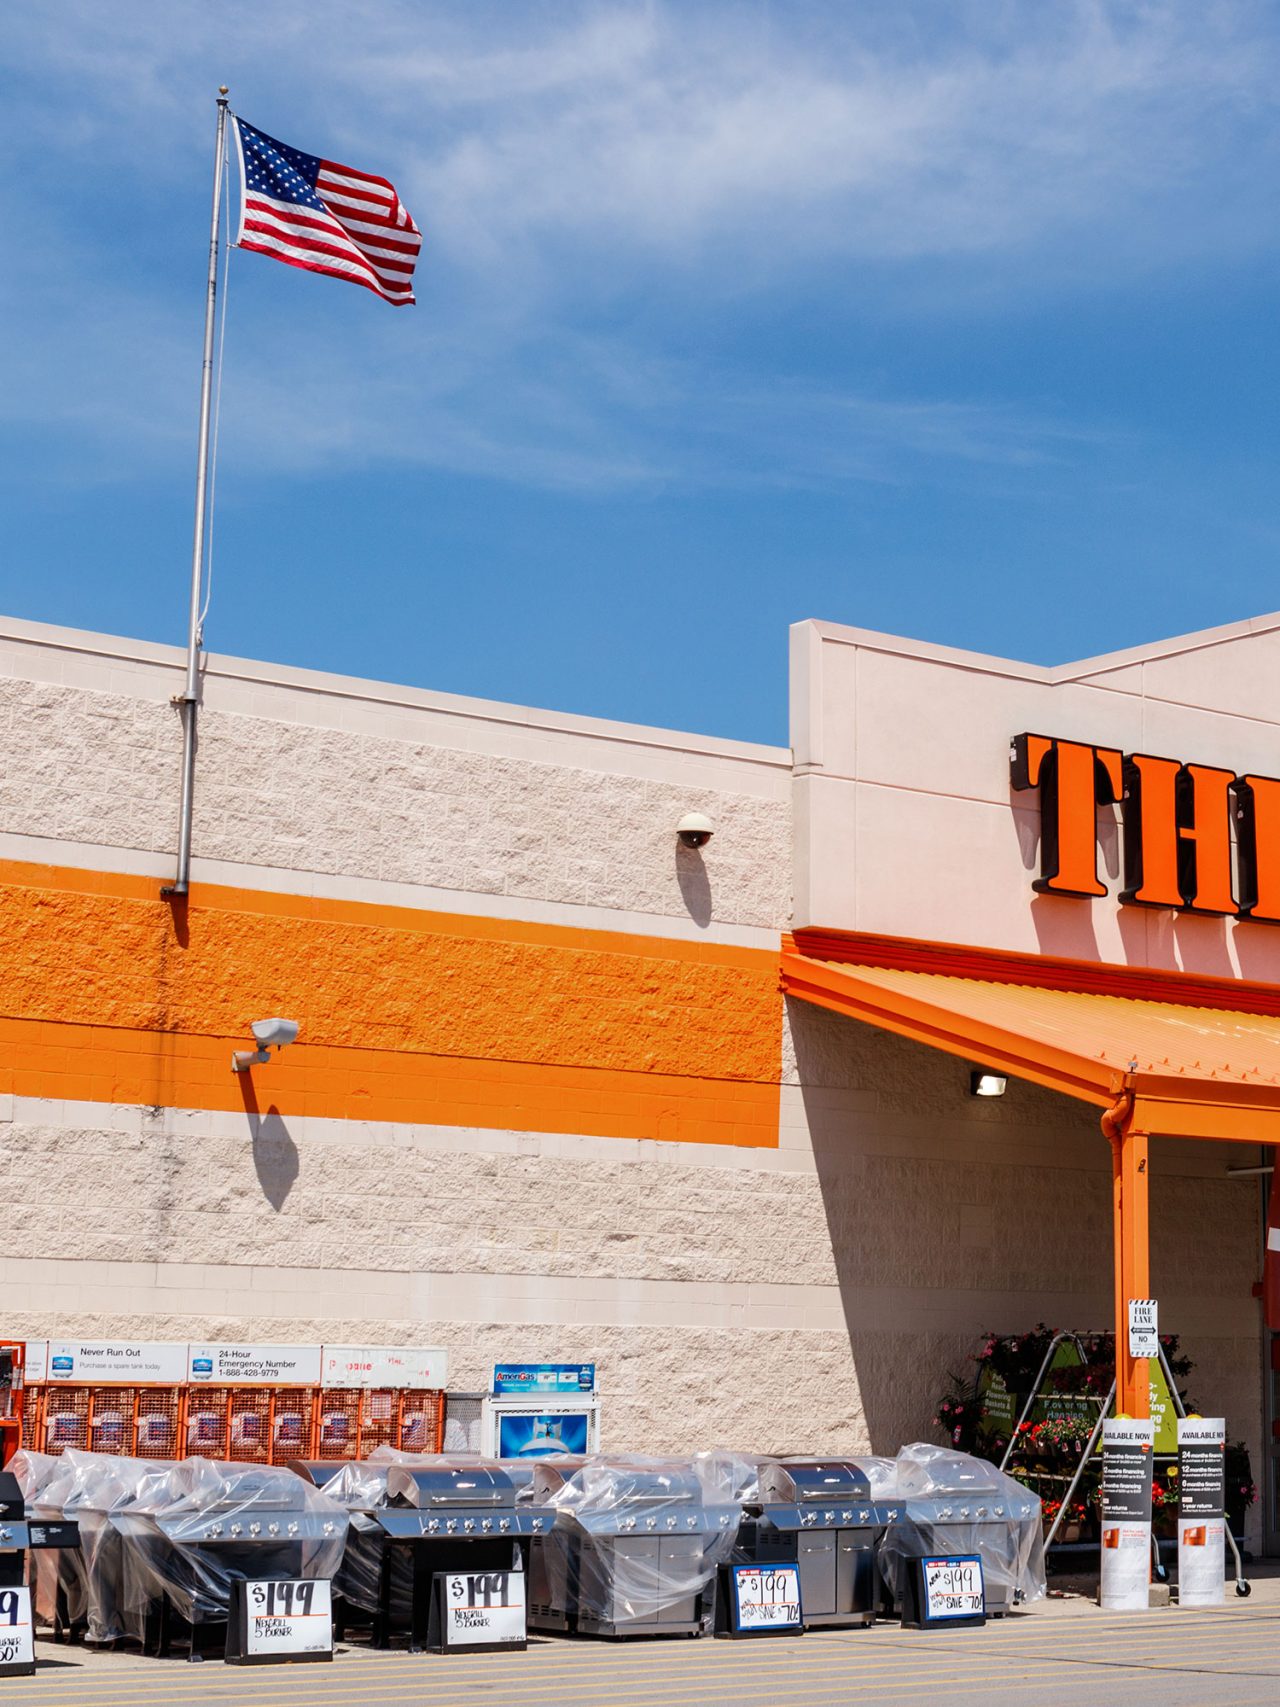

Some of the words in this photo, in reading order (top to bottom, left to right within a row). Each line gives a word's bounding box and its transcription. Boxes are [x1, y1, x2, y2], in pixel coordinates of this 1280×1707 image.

[1134, 1307, 1152, 1315] FIRE
[1134, 1315, 1153, 1324] LANE
[1138, 1335, 1148, 1343] NO
[80, 1347, 104, 1357] Never
[106, 1348, 124, 1357] Run
[125, 1348, 141, 1357] Out
[218, 1350, 251, 1358] 24-Hour
[80, 1361, 107, 1370] Purchase
[113, 1364, 130, 1372] spare
[131, 1362, 144, 1370] tank
[144, 1363, 161, 1372] today
[218, 1359, 264, 1369] Emergency
[265, 1360, 296, 1369] Number
[218, 1369, 279, 1377] 1-888-428-9779
[496, 1372, 535, 1381] AmeriGas
[985, 1390, 1011, 1402] Flowering
[1134, 1432, 1150, 1440] NOW
[1182, 1431, 1216, 1439] AVAILABLE
[1124, 1453, 1146, 1461] financing
[1182, 1450, 1191, 1459] 24
[1122, 1468, 1145, 1476] financing
[1181, 1465, 1190, 1473] 12
[944, 1568, 973, 1592] $199
[451, 1572, 509, 1608] $199
[751, 1574, 787, 1605] $199
[252, 1582, 315, 1616] $199
[946, 1596, 962, 1609] SAVE
[759, 1605, 777, 1620] SAVE
[456, 1619, 464, 1628] 5
[254, 1627, 263, 1639] 5
[265, 1626, 293, 1638] BURNER
